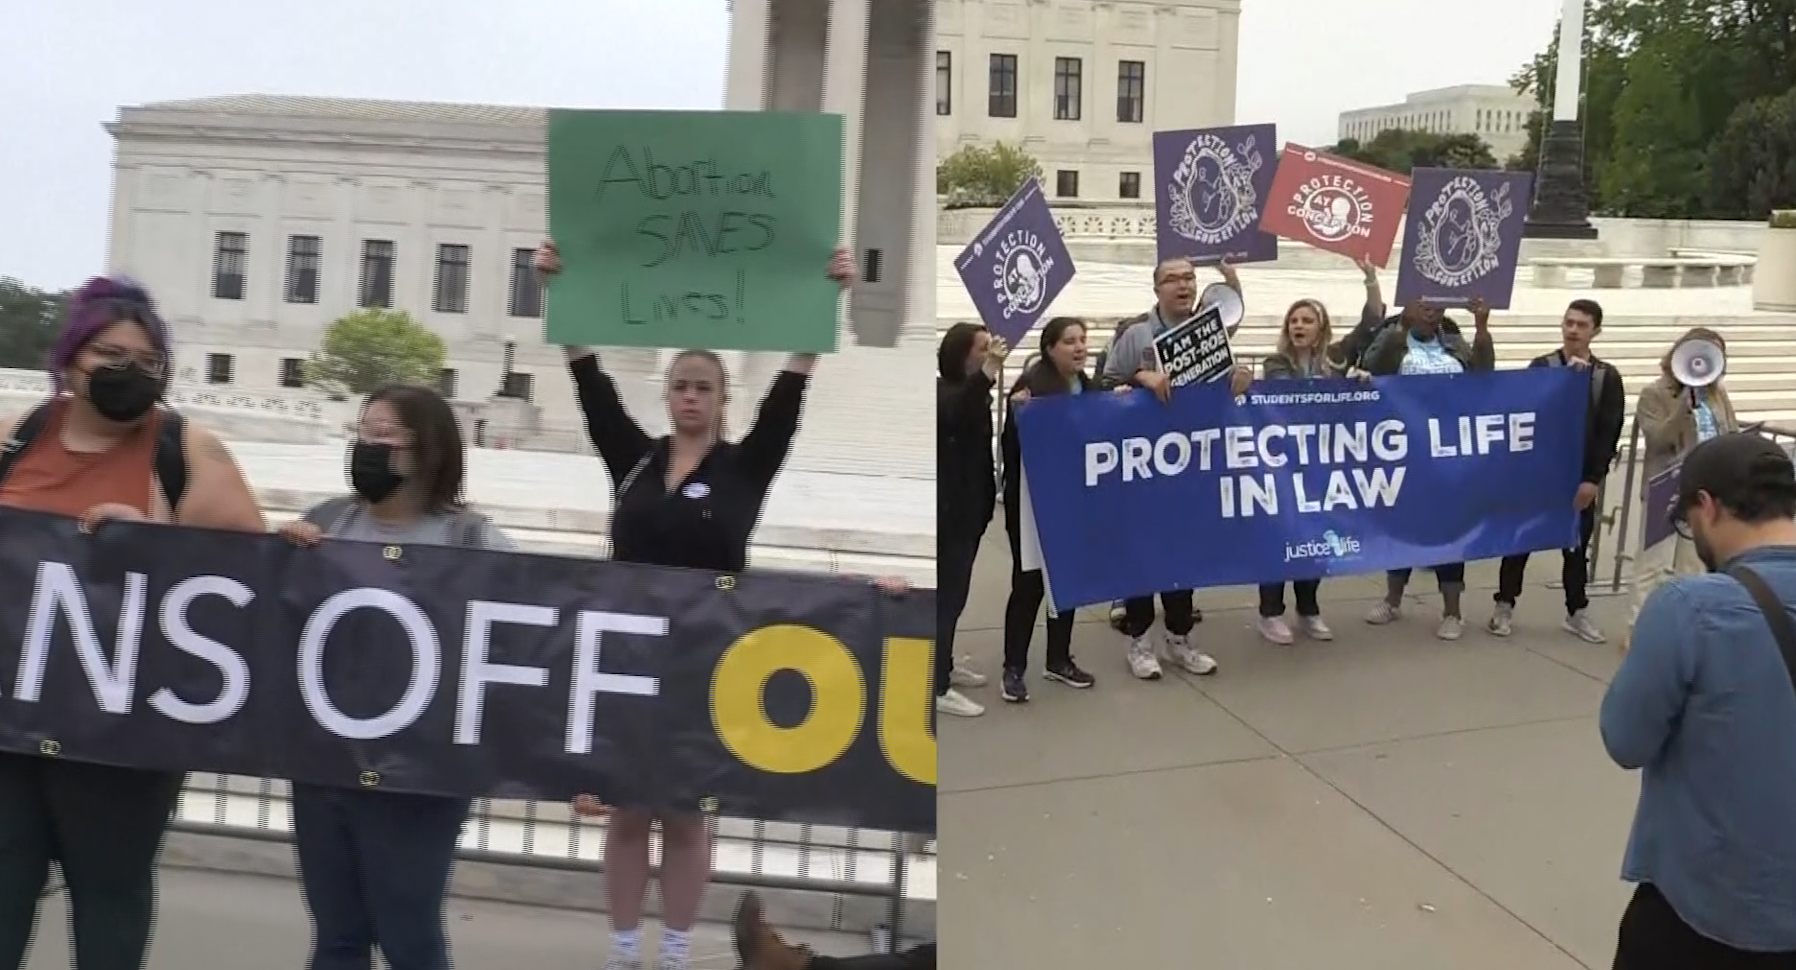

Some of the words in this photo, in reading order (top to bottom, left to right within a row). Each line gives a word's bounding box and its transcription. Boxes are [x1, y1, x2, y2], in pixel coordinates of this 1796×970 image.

[1173, 134, 1239, 187] PROTECTION
[1293, 175, 1374, 223] PROTECTION
[1313, 195, 1332, 207] AT
[1425, 176, 1490, 226] PROTECTION
[635, 209, 778, 268] SAVES
[993, 229, 1047, 304] PROTECTION
[1003, 256, 1055, 320] CONCEION
[1163, 349, 1169, 361] I
[1173, 336, 1192, 354] AM
[1194, 318, 1219, 339] THE
[1164, 331, 1226, 375] POST-ROE
[1250, 390, 1381, 407] STUDENTSFORLIFE.ORG
[1084, 419, 1409, 487] PROTECTING
[1428, 412, 1537, 458] LIFE
[1221, 472, 1280, 519] IN
[1292, 465, 1407, 514] LAW
[0, 558, 256, 725] NS
[296, 586, 671, 755] OFF
